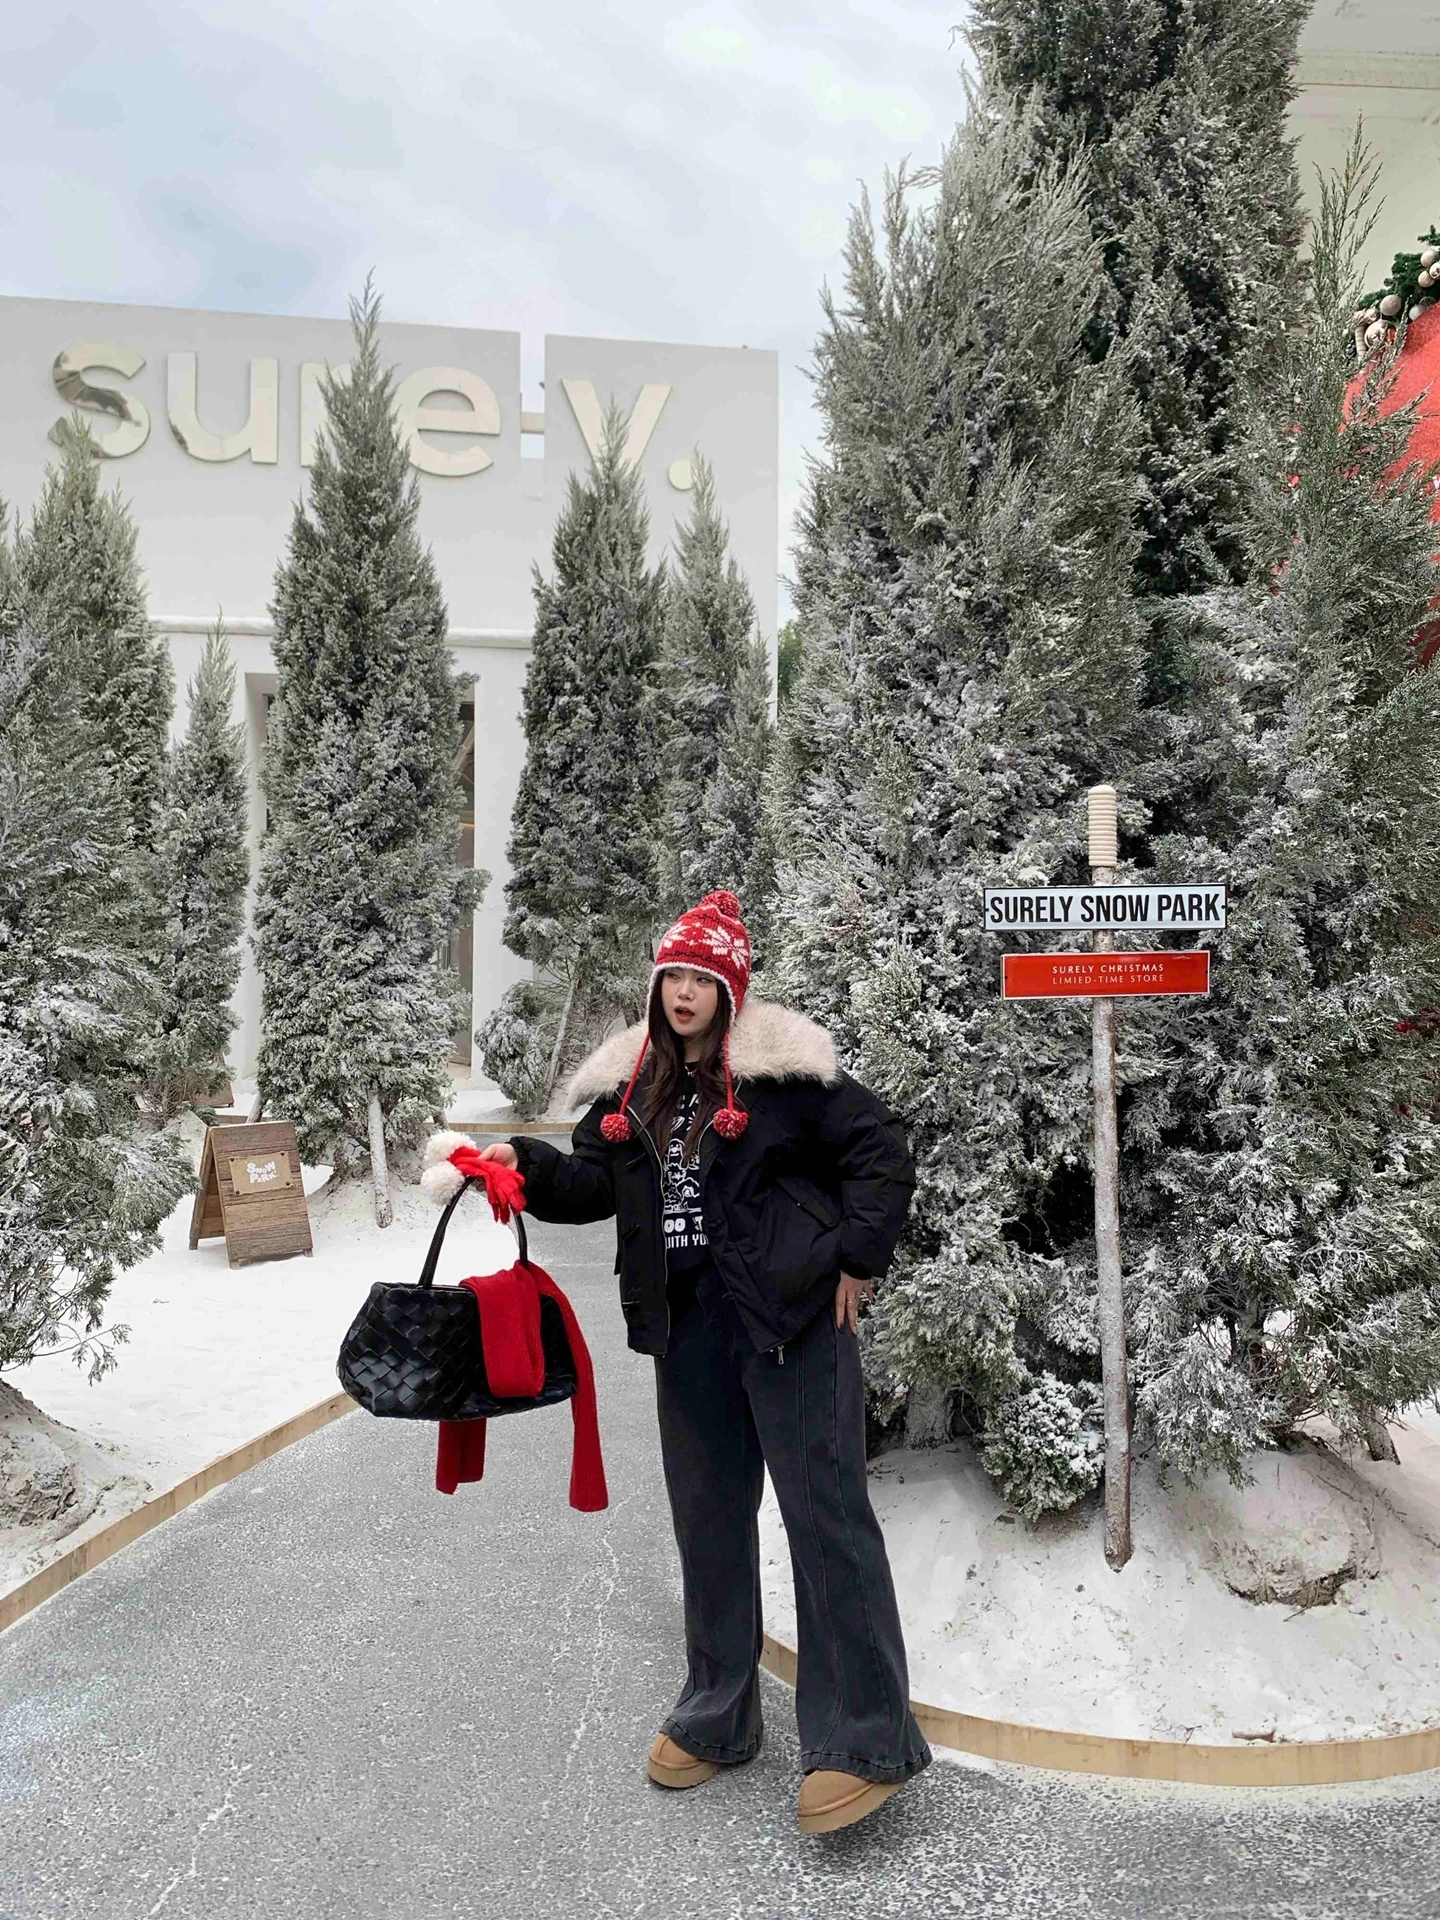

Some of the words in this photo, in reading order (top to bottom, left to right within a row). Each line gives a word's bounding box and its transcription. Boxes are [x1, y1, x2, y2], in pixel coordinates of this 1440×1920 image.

[990, 895, 1073, 923] SURELY
[1080, 894, 1150, 922] SNOW
[1157, 893, 1220, 921] PARK
[1052, 965, 1094, 974] SURELY
[1100, 963, 1164, 973] CHRISTMAS
[1130, 973, 1164, 983] STORE
